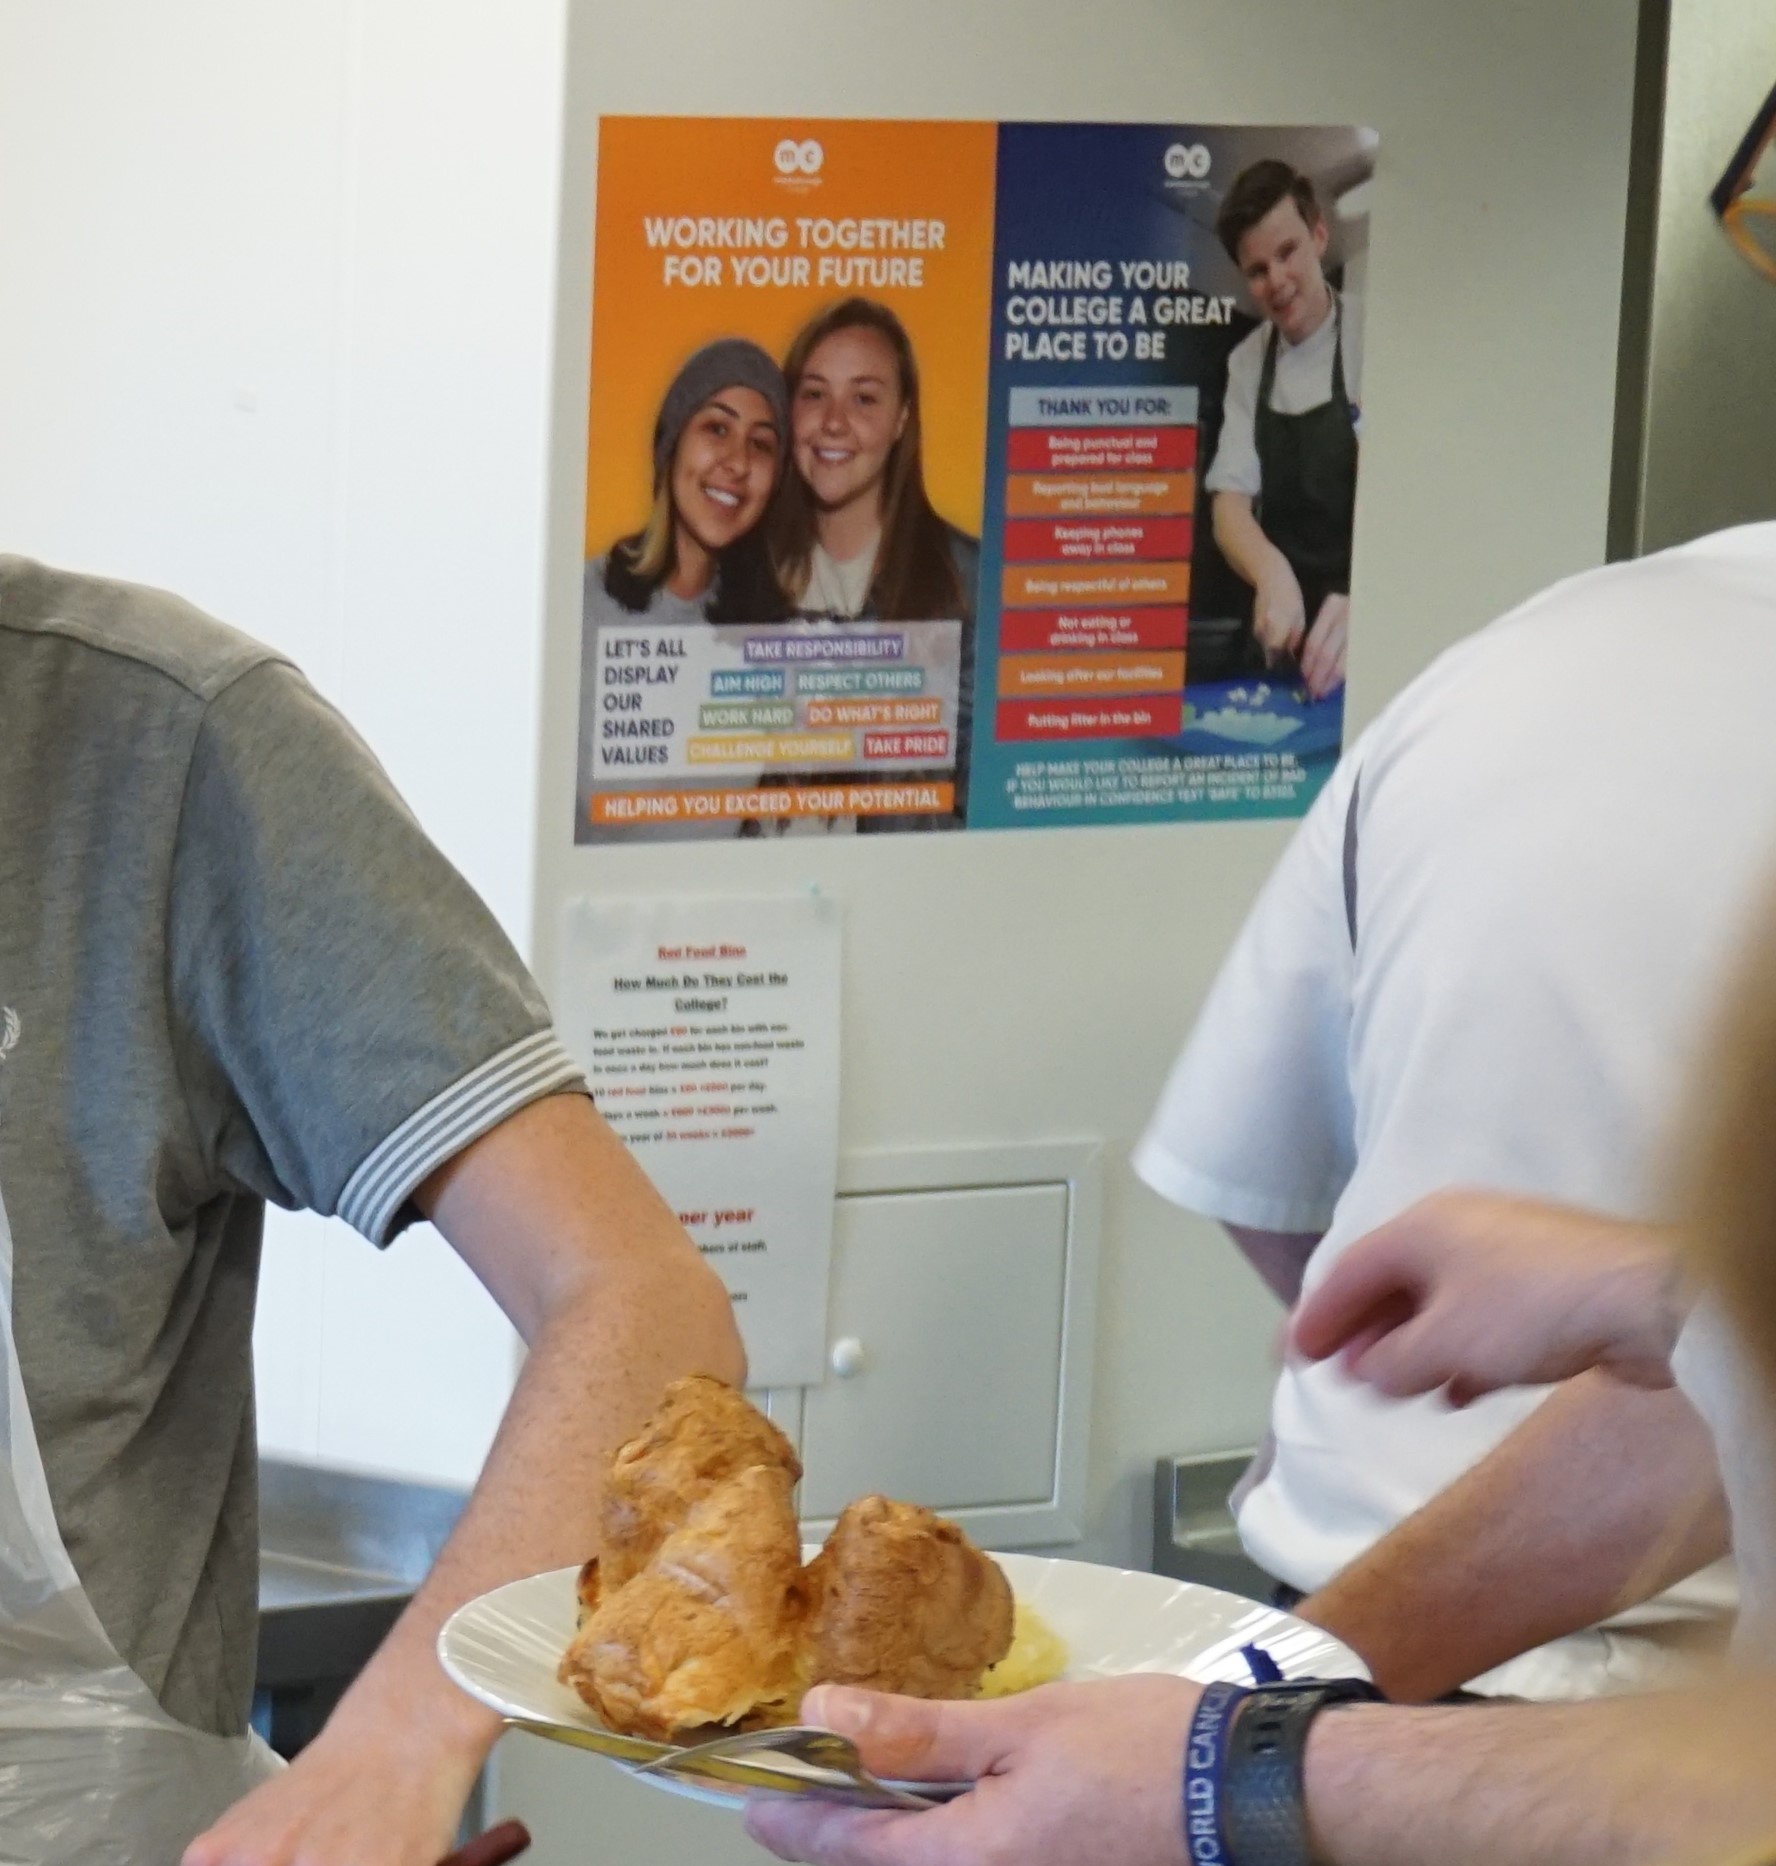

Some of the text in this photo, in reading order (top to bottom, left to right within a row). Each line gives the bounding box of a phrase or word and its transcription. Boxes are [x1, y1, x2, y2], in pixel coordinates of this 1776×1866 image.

[644, 216, 946, 249] WORKING TOGETHER
[663, 255, 924, 287] FOR YOUR FUTURE
[1008, 260, 1190, 290] MAKING YOUR
[1006, 295, 1236, 325] COLLEGE A GREAT
[1005, 331, 1166, 361] PLACE TO BE
[1038, 397, 1171, 416] THANK YOU FOR:
[605, 639, 687, 659] LET'S ALL
[747, 639, 902, 659] TAKE RESPONSIBILITY
[604, 665, 679, 685] DISPLAY
[713, 674, 783, 693] AIM HIGH
[797, 670, 921, 690] RESPECT OTHERS
[603, 693, 642, 712] OUR
[810, 703, 939, 722] DO WHAT'S RIGHT
[701, 707, 793, 725] WORK HARD
[602, 719, 675, 739] SHARED
[602, 745, 669, 764] VALUES
[689, 739, 852, 759] CHALLENGE YOURSELF
[866, 735, 947, 755] TAKE PRIDE
[605, 789, 941, 817] HELPING YOU EXCEED YOUR POTENTIAL
[658, 946, 681, 959] Red
[614, 977, 641, 990] How
[645, 976, 678, 989] Much
[683, 975, 699, 988] Do
[703, 974, 732, 988] They
[768, 972, 788, 985] the
[675, 997, 727, 1012] College?
[713, 1208, 753, 1228] year
